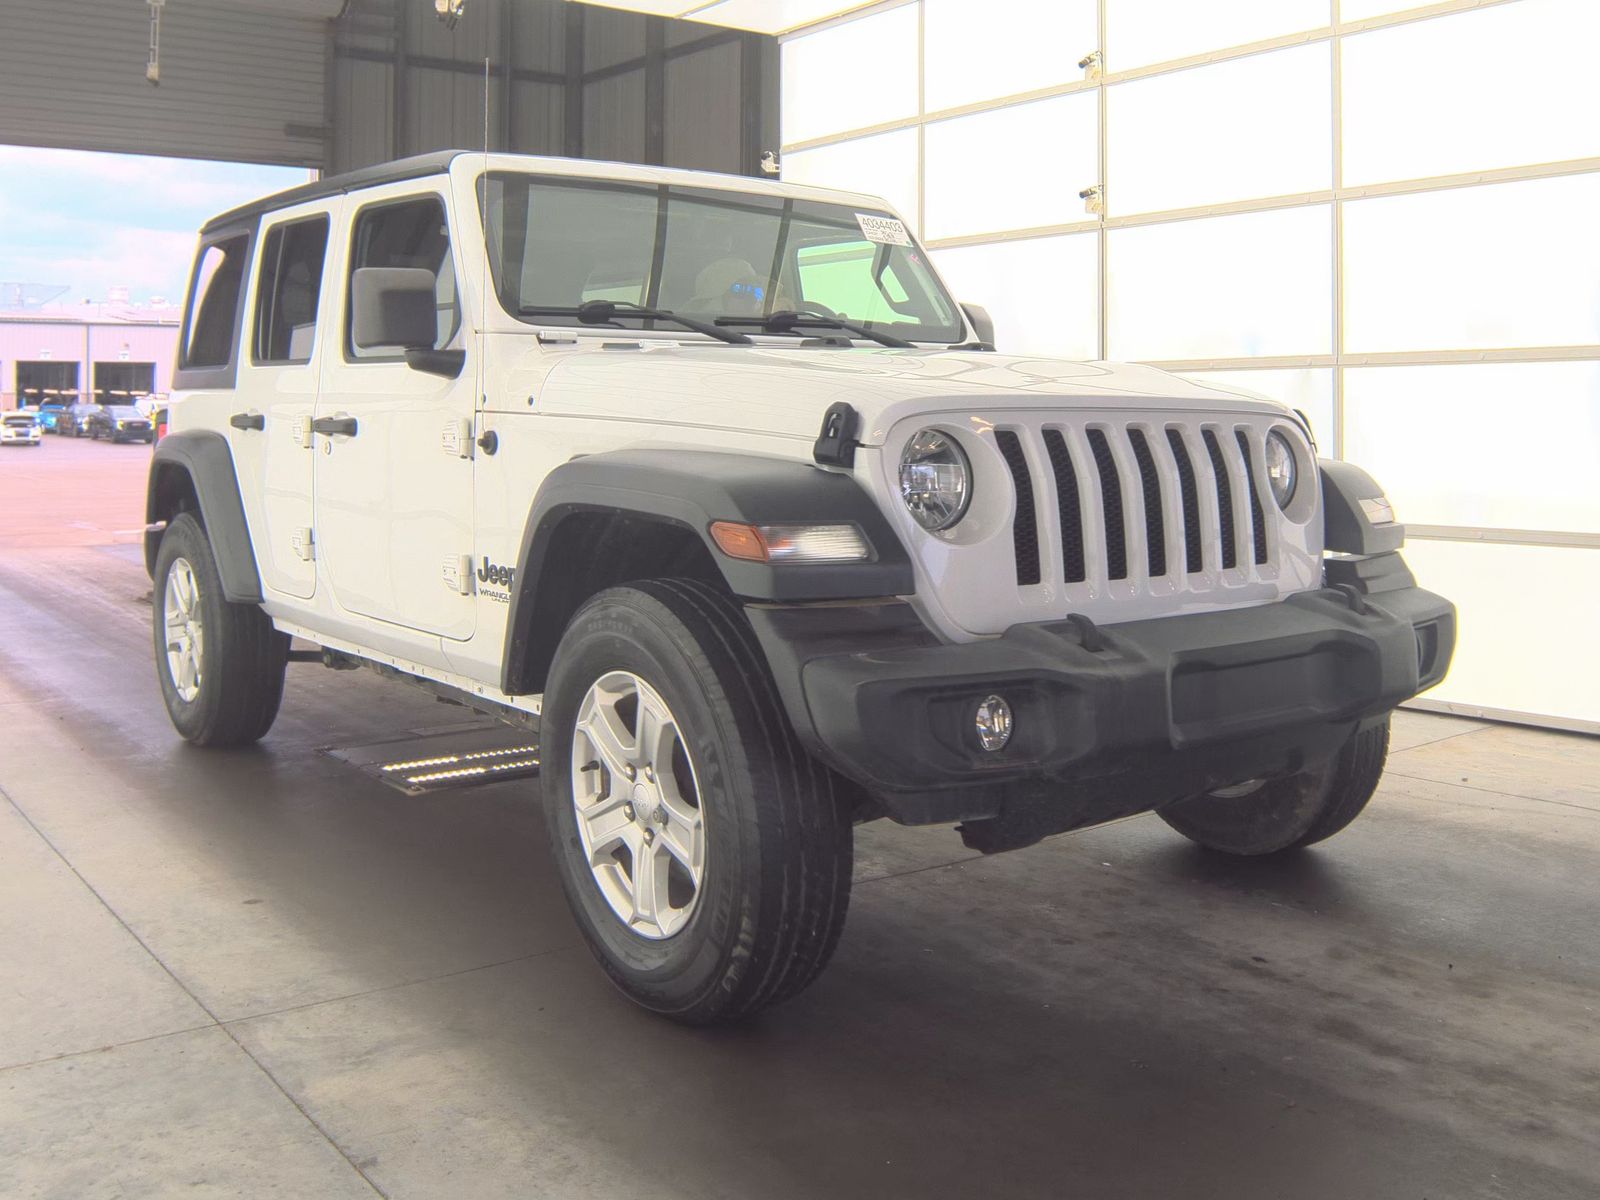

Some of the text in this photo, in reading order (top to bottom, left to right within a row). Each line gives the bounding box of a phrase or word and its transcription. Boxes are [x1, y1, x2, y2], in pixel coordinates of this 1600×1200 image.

[862, 217, 903, 233] 4034403
[477, 556, 516, 592] Jeep
[479, 588, 511, 600] WRANGL
